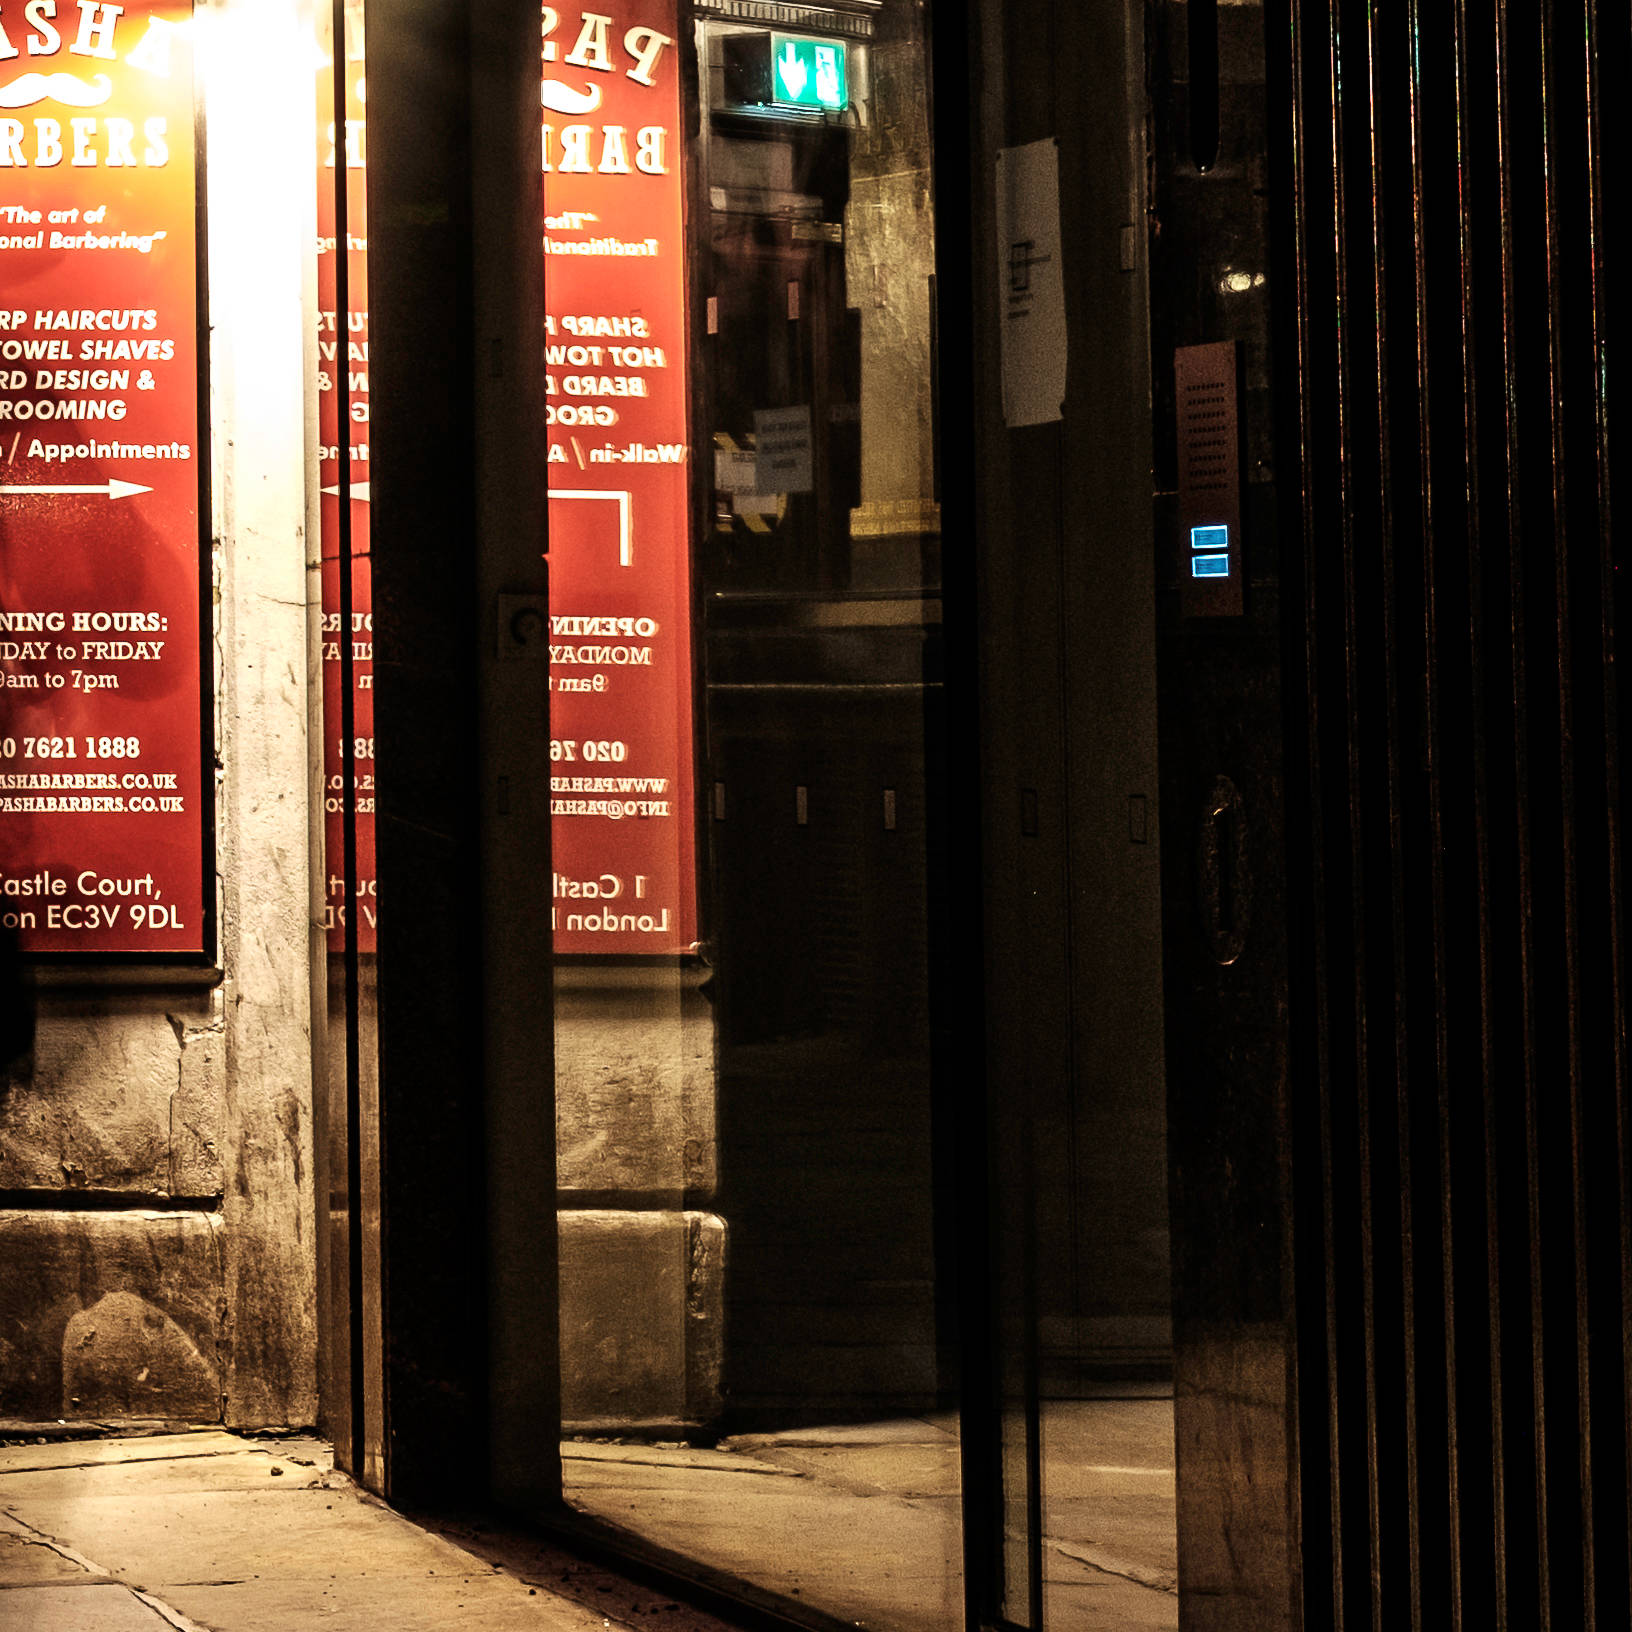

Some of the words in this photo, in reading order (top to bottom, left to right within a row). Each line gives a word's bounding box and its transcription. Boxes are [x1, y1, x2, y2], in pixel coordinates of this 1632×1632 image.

[48, 208, 78, 224] art
[84, 205, 107, 224] of
[34, 309, 157, 331] HAIRCUTS
[79, 339, 175, 361] SHAVES
[35, 369, 130, 390] DESIGN
[136, 370, 155, 390] &
[27, 438, 191, 463] Appointments
[72, 612, 169, 632] HOURS:
[56, 643, 77, 660] to
[82, 641, 165, 660] FRIDAY
[45, 671, 65, 688] to
[71, 670, 120, 693] 7pm
[23, 737, 77, 758] 7621
[85, 736, 140, 758] 1888
[77, 870, 162, 901] Court,
[47, 904, 121, 929] EC3V
[129, 904, 185, 930] 9DL
